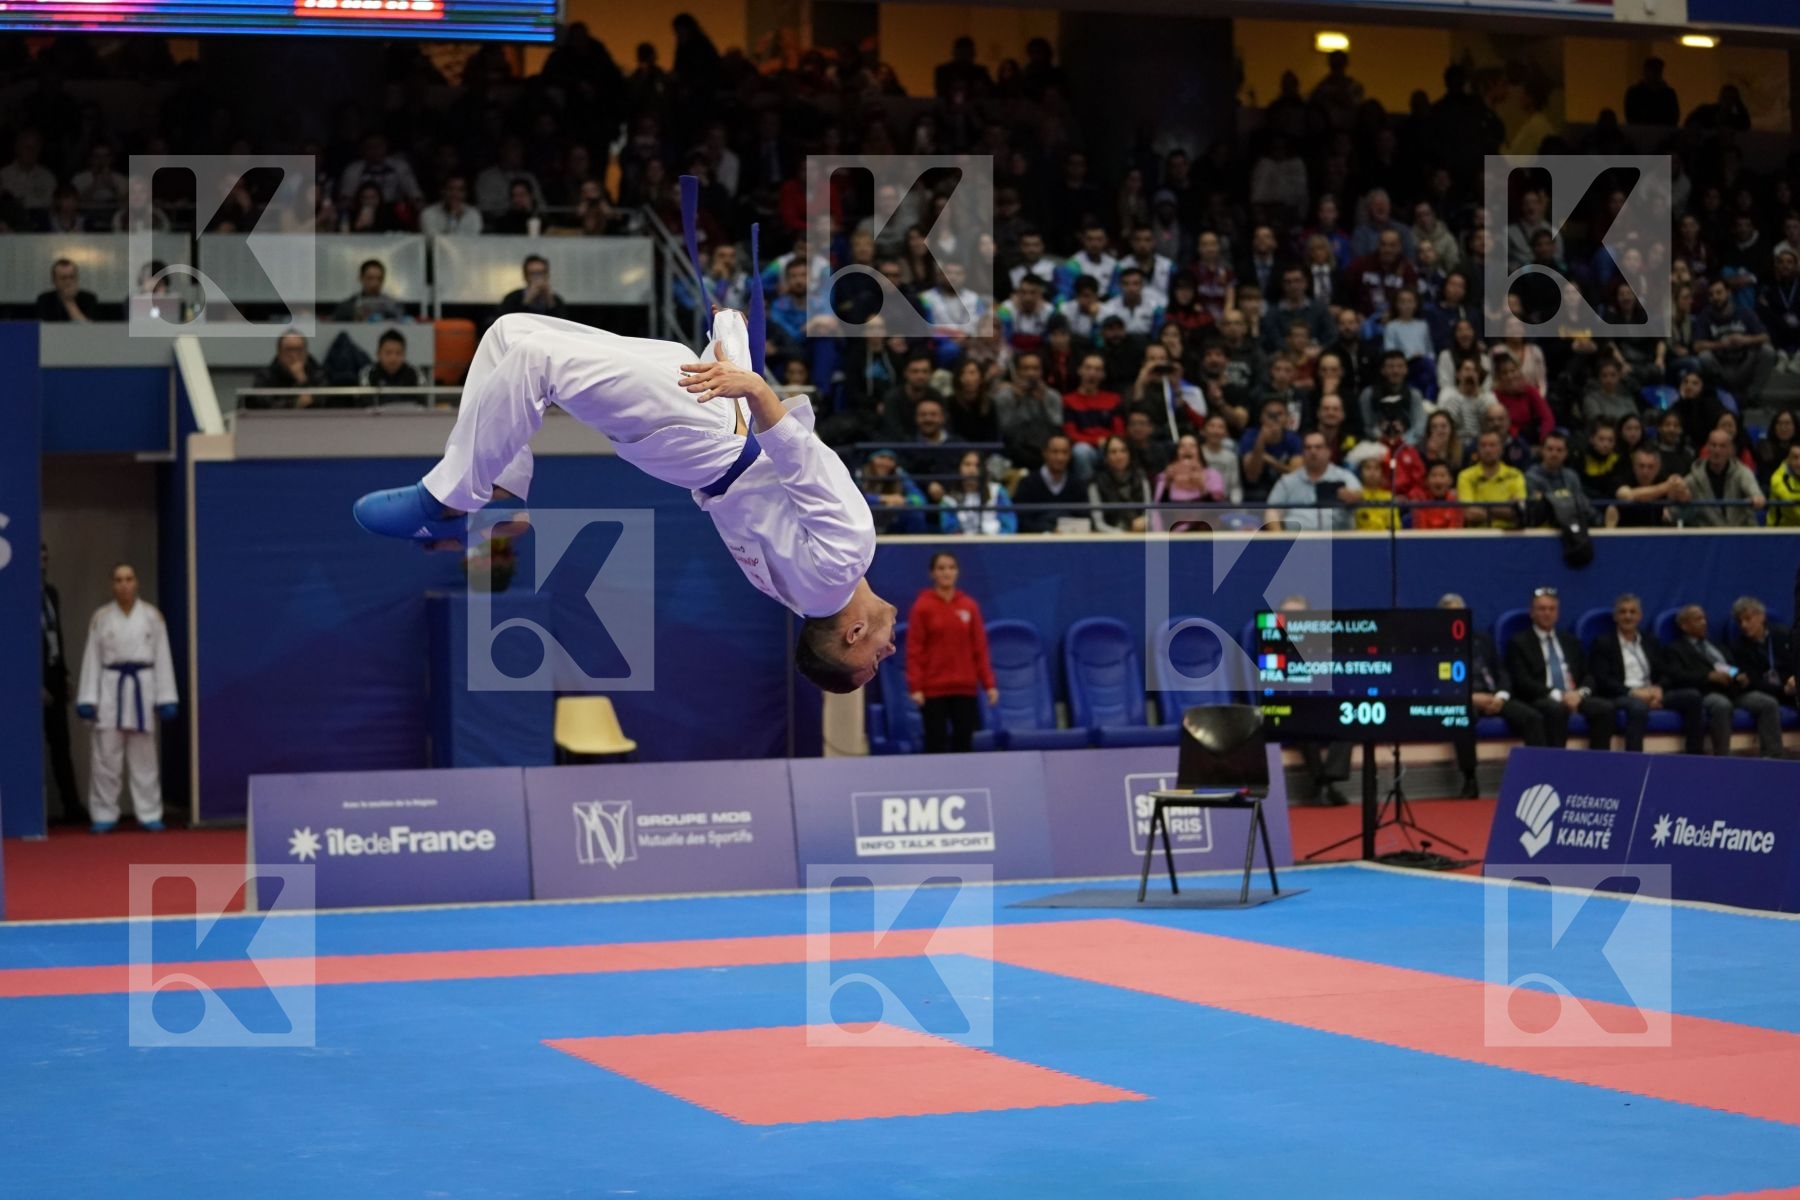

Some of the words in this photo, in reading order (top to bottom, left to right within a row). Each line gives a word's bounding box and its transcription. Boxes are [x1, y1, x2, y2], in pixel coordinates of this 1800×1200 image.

[1287, 620, 1344, 633] MARESCA
[1345, 620, 1378, 633] LUCA
[1451, 619, 1465, 640] 0
[1262, 629, 1281, 641] ITA
[1260, 669, 1284, 682] FRA
[1287, 661, 1344, 675] DACOSTA
[1345, 661, 1392, 675] STEVEN
[1452, 660, 1466, 682] 0
[1339, 702, 1386, 725] 3:00
[1566, 794, 1620, 811] FÉDÉRATION
[637, 813, 707, 827] GROUPE
[882, 795, 966, 833] RMC
[1562, 809, 1616, 827] FRANÇAISE
[686, 832, 706, 845] des
[861, 840, 895, 850] INFO
[900, 839, 936, 849] TALK
[940, 837, 991, 848] SPORT
[1556, 827, 1612, 850] KARATÉ
